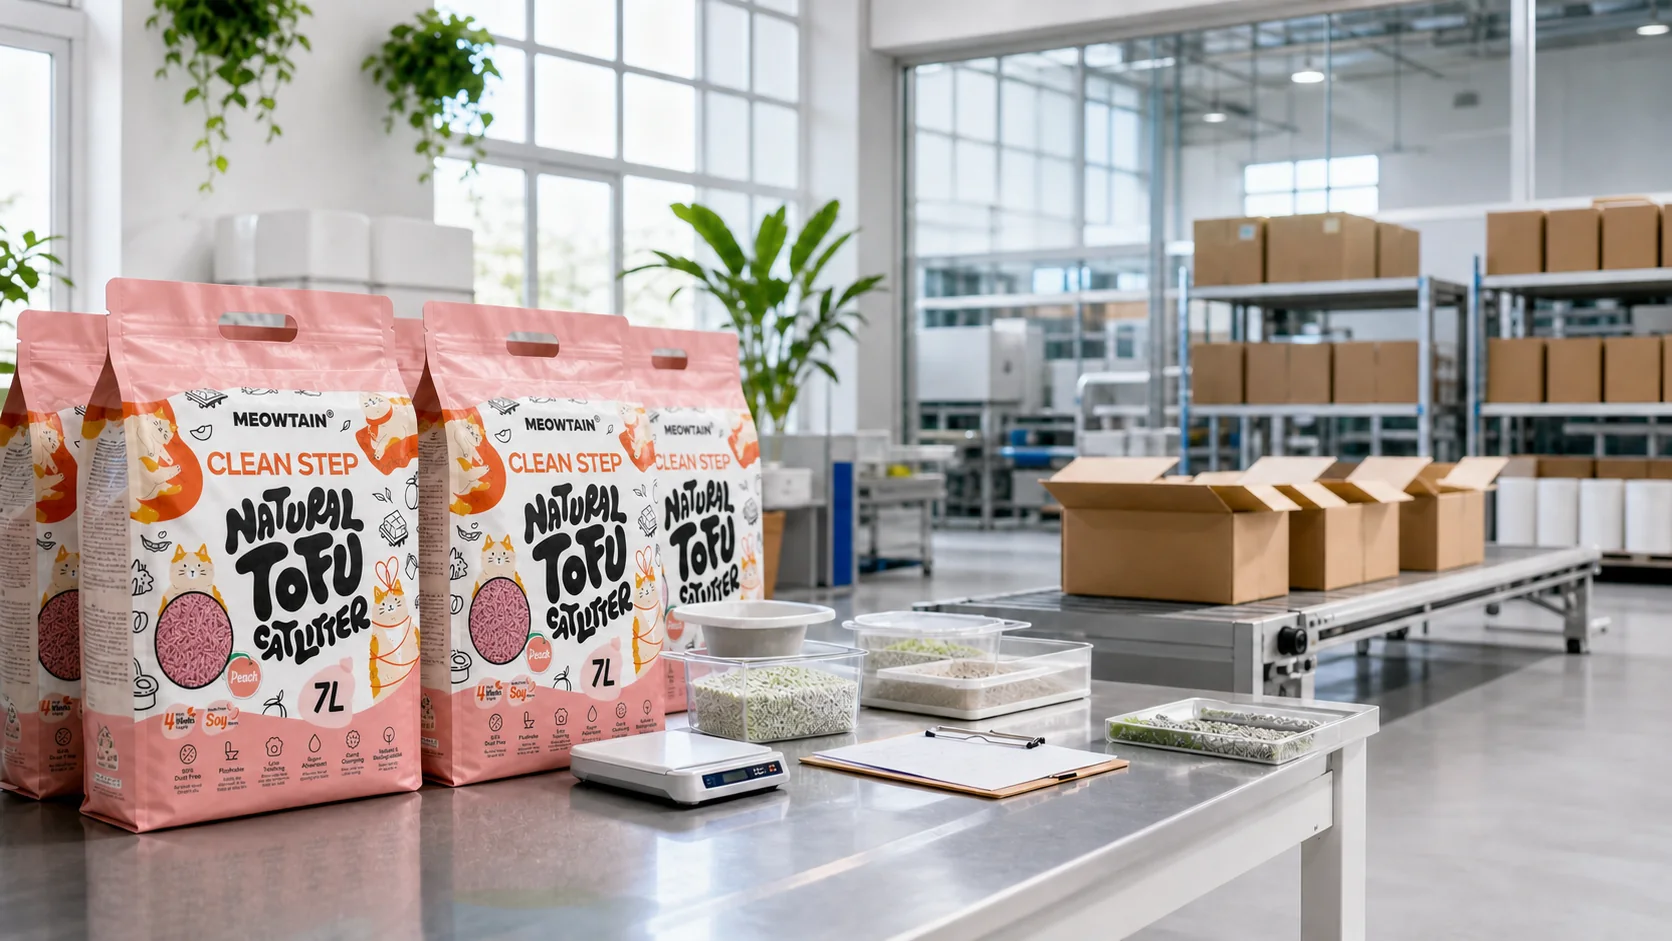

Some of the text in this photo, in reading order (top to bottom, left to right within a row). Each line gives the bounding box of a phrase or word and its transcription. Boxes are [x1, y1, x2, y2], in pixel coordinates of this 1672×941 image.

[207, 451, 359, 476] CLEAN STEP
[508, 451, 623, 474] CLEAN STEP
[655, 453, 731, 471] CLEAN STEP
[524, 482, 628, 545] NATURAL
[664, 479, 735, 532] NATURAL
[225, 486, 365, 556] NATURAL
[230, 669, 259, 685] Peach
[591, 658, 615, 688] 7L
[313, 680, 345, 714] 7L
[476, 685, 486, 701] 4
[509, 685, 527, 702] Soy
[40, 699, 51, 716] 4
[164, 712, 175, 730] 4
[205, 712, 228, 730] Soy
